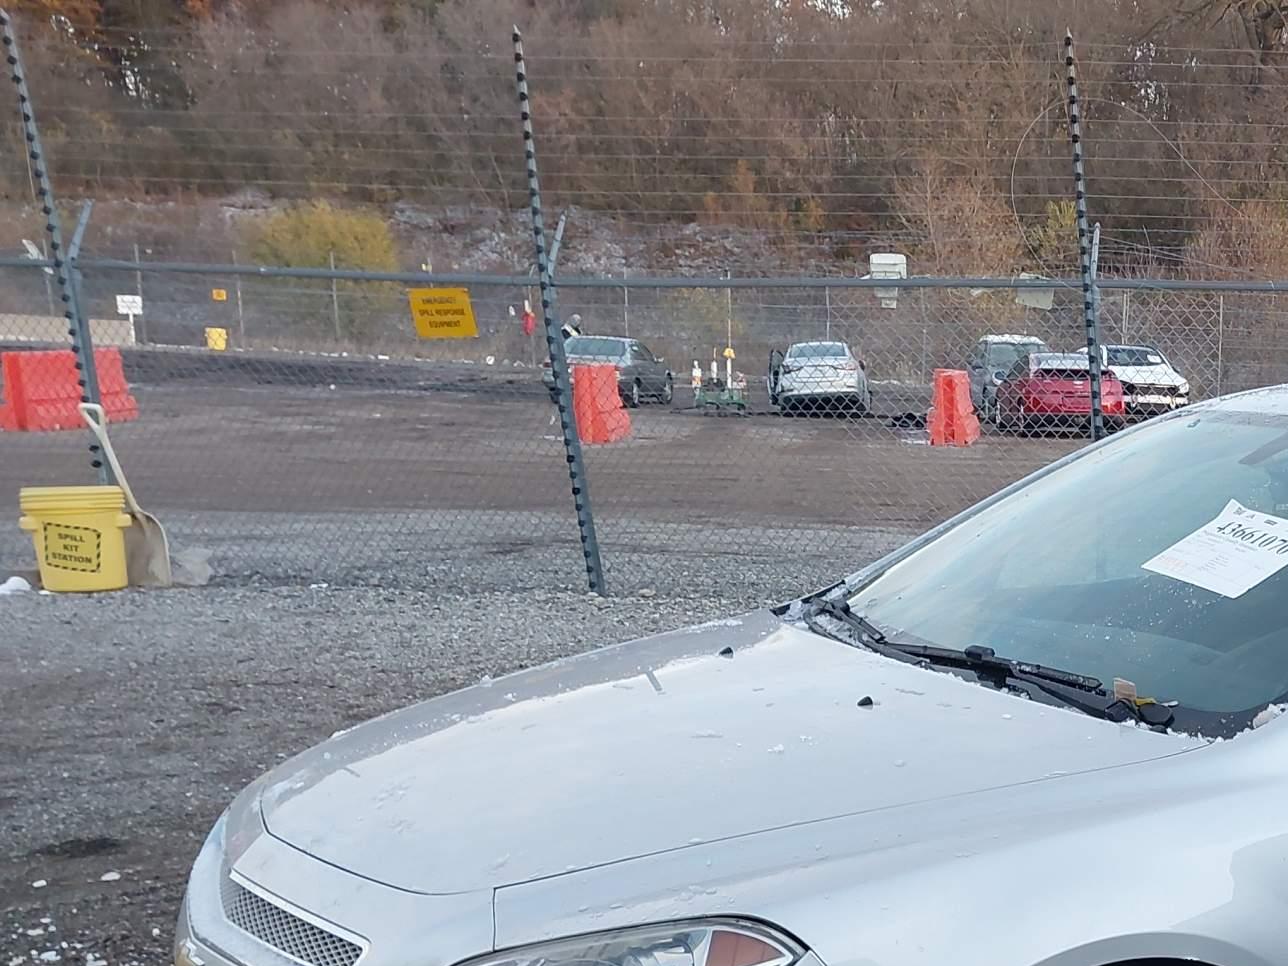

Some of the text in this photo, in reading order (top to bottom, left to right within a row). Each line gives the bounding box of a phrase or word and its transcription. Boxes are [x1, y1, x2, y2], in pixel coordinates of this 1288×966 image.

[57, 532, 86, 543] SPILL
[63, 544, 79, 552] KIT
[51, 552, 93, 564] STATION
